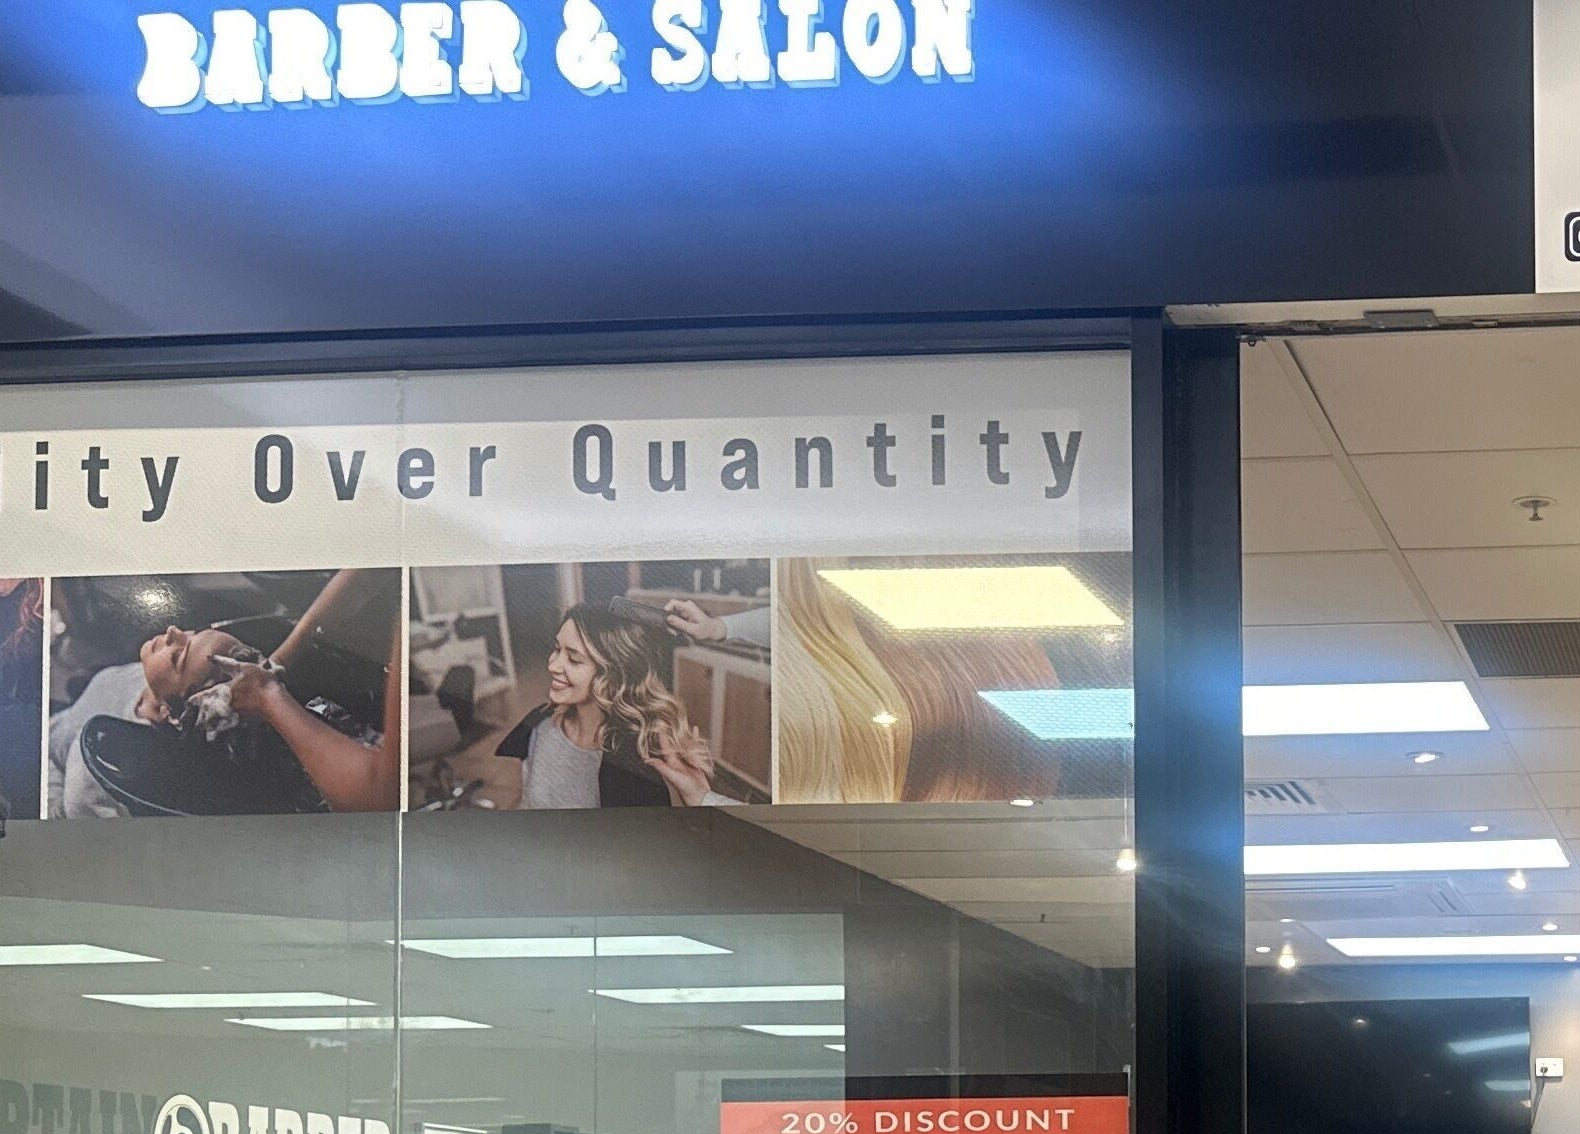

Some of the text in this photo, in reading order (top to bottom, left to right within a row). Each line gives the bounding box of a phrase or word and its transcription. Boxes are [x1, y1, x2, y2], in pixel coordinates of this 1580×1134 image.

[137, 0, 975, 114] BARBER & SALON
[254, 433, 498, 504] Over
[573, 414, 1083, 503] Quantity
[781, 1108, 1076, 1134] 20% DISCOUNT
